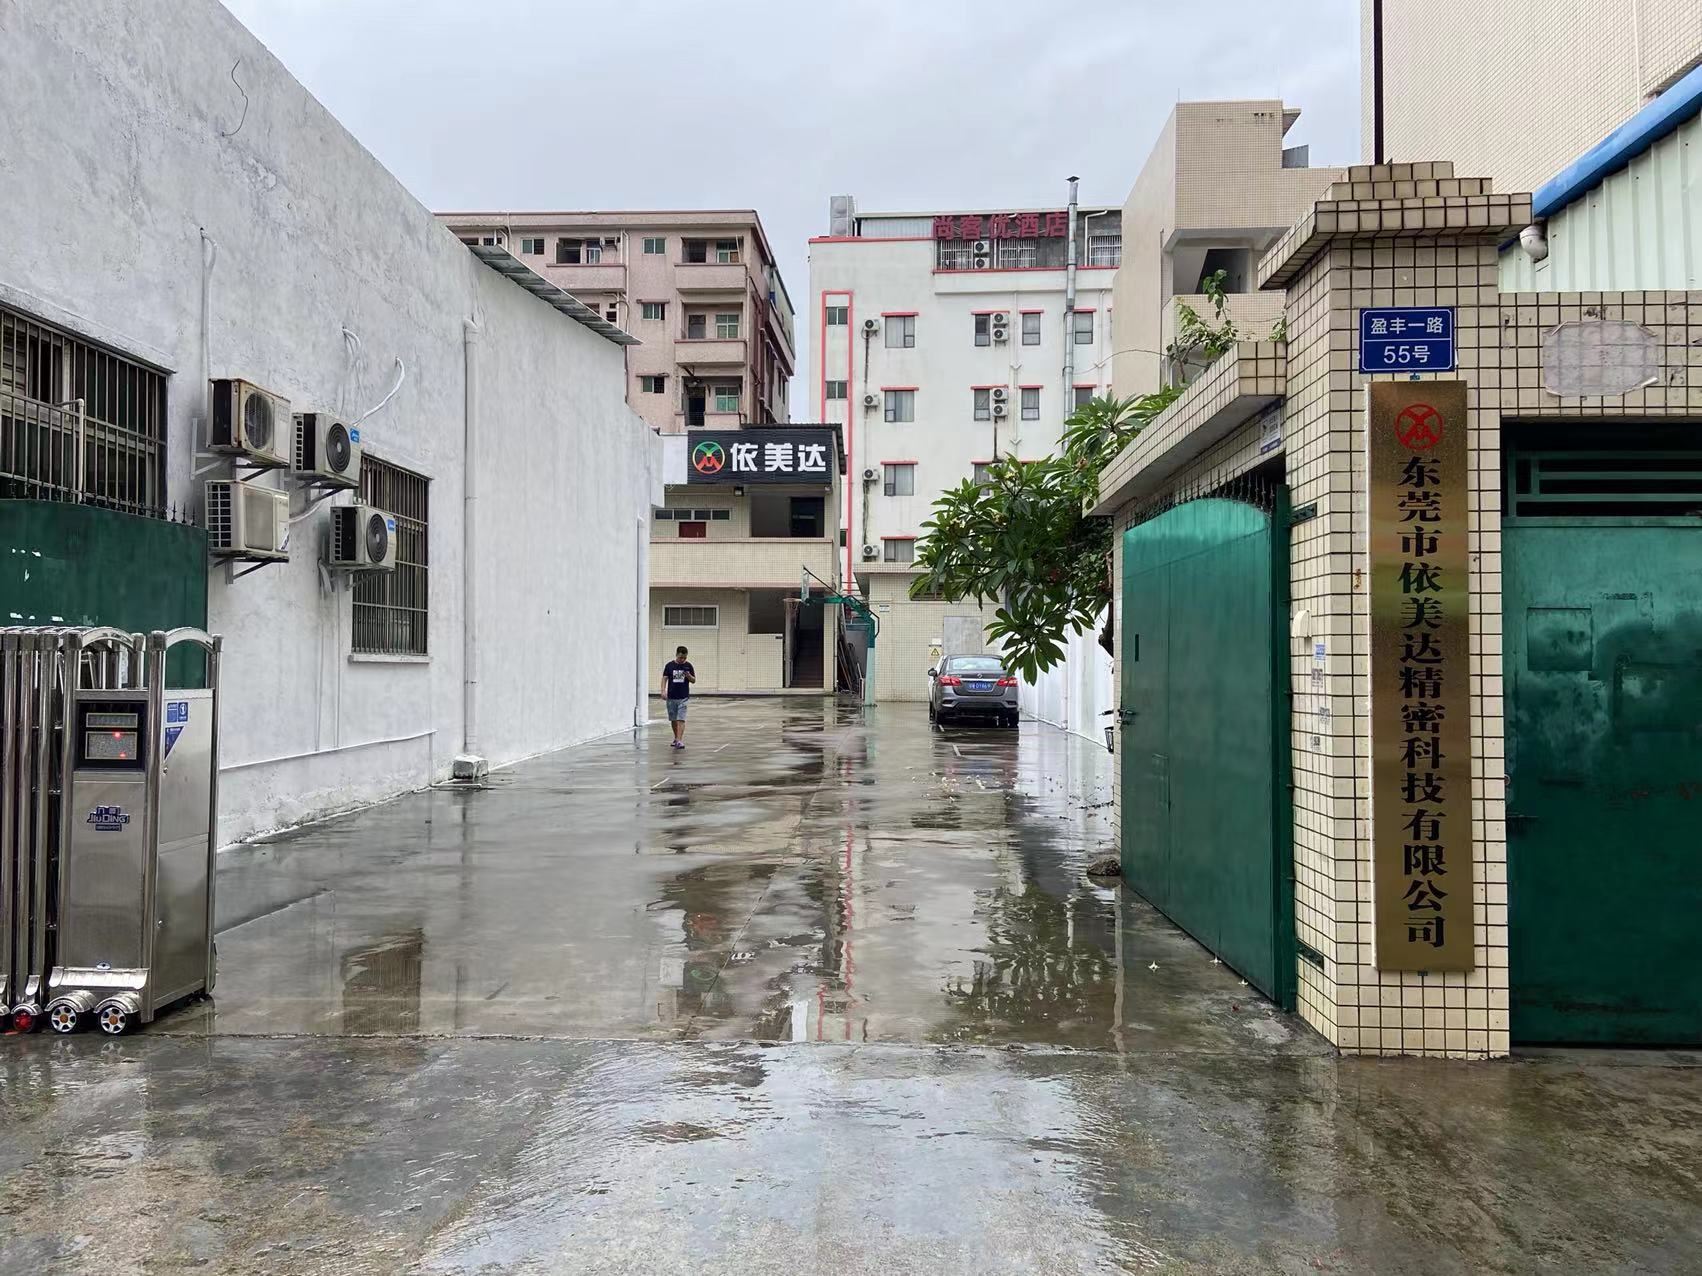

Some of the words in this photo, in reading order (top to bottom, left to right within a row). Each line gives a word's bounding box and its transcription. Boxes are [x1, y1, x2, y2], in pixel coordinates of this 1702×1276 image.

[933, 212, 1068, 240] 尚客优酒店
[1370, 316, 1443, 334] 盈丰一路
[1383, 345, 1430, 363] 55号
[730, 442, 827, 472] 依美达
[1397, 456, 1448, 948] 东莞市依美达精密科技有限公司
